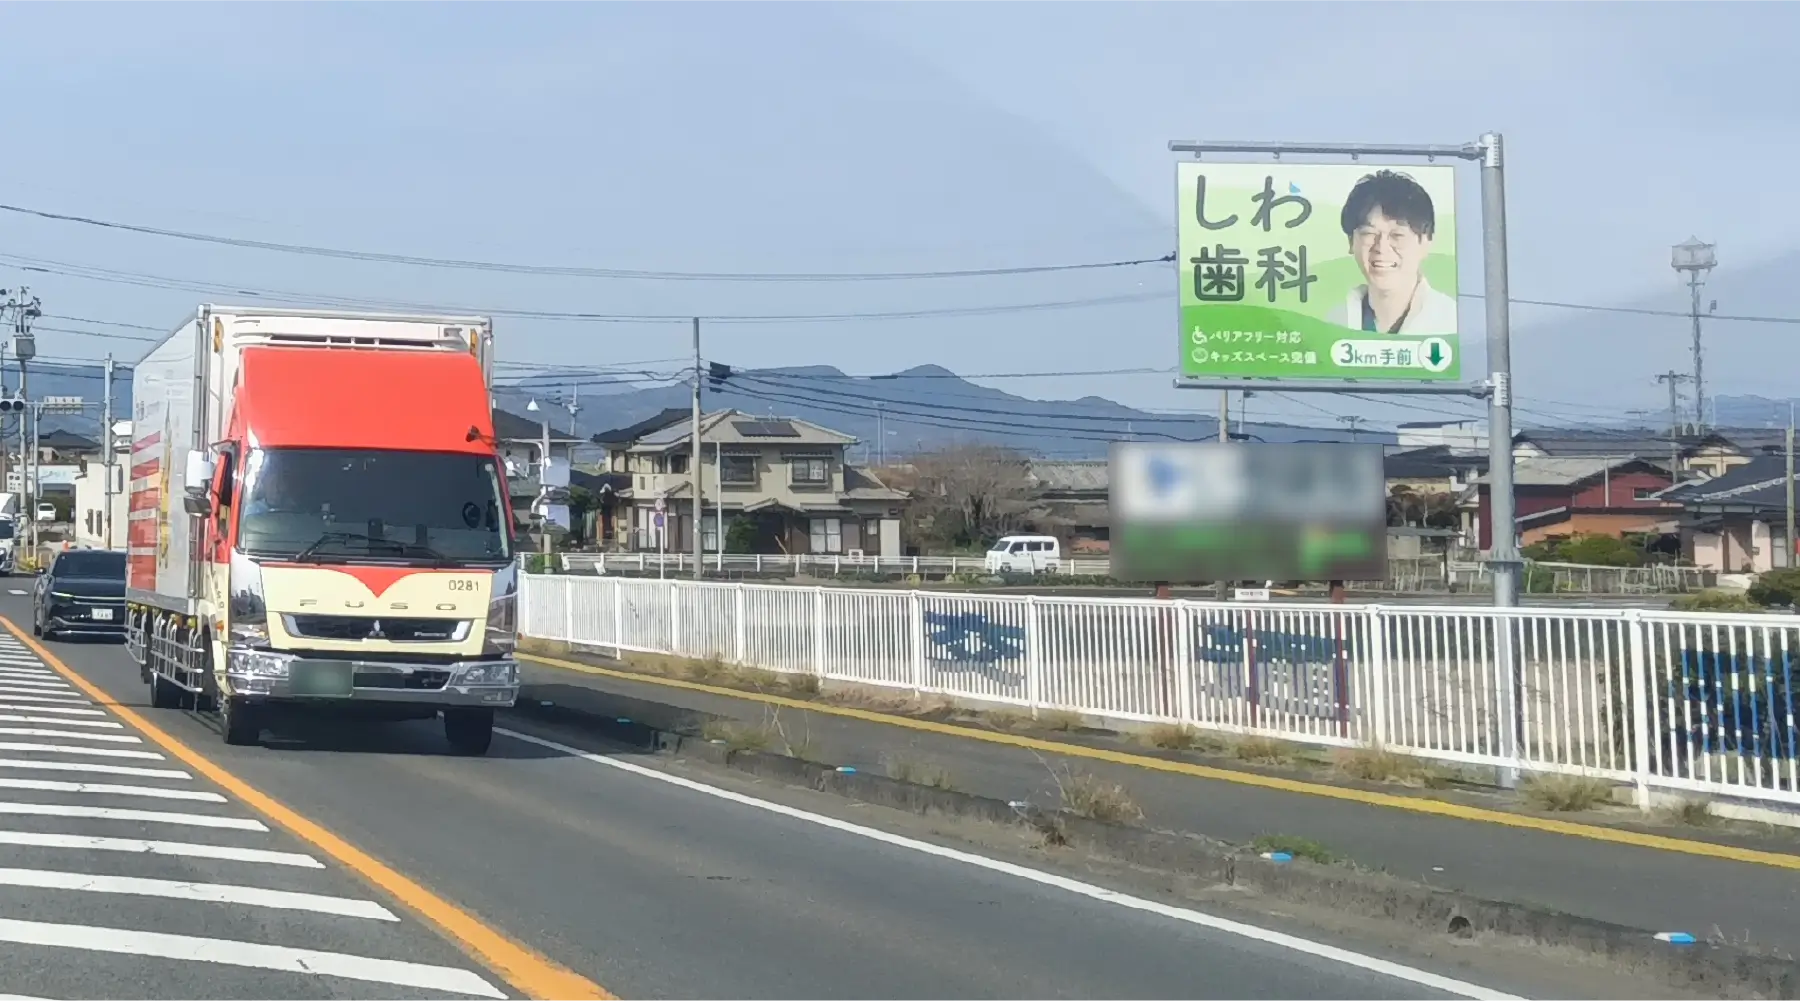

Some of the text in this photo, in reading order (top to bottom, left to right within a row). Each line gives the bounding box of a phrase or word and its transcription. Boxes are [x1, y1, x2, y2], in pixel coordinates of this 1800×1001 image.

[1195, 175, 1312, 232] しわ
[1190, 243, 1317, 304] 歯科
[1209, 330, 1302, 344] バリアフリー対応
[1340, 342, 1412, 366] 3km手前
[448, 579, 479, 591] 0281
[300, 599, 457, 610] FUSO
